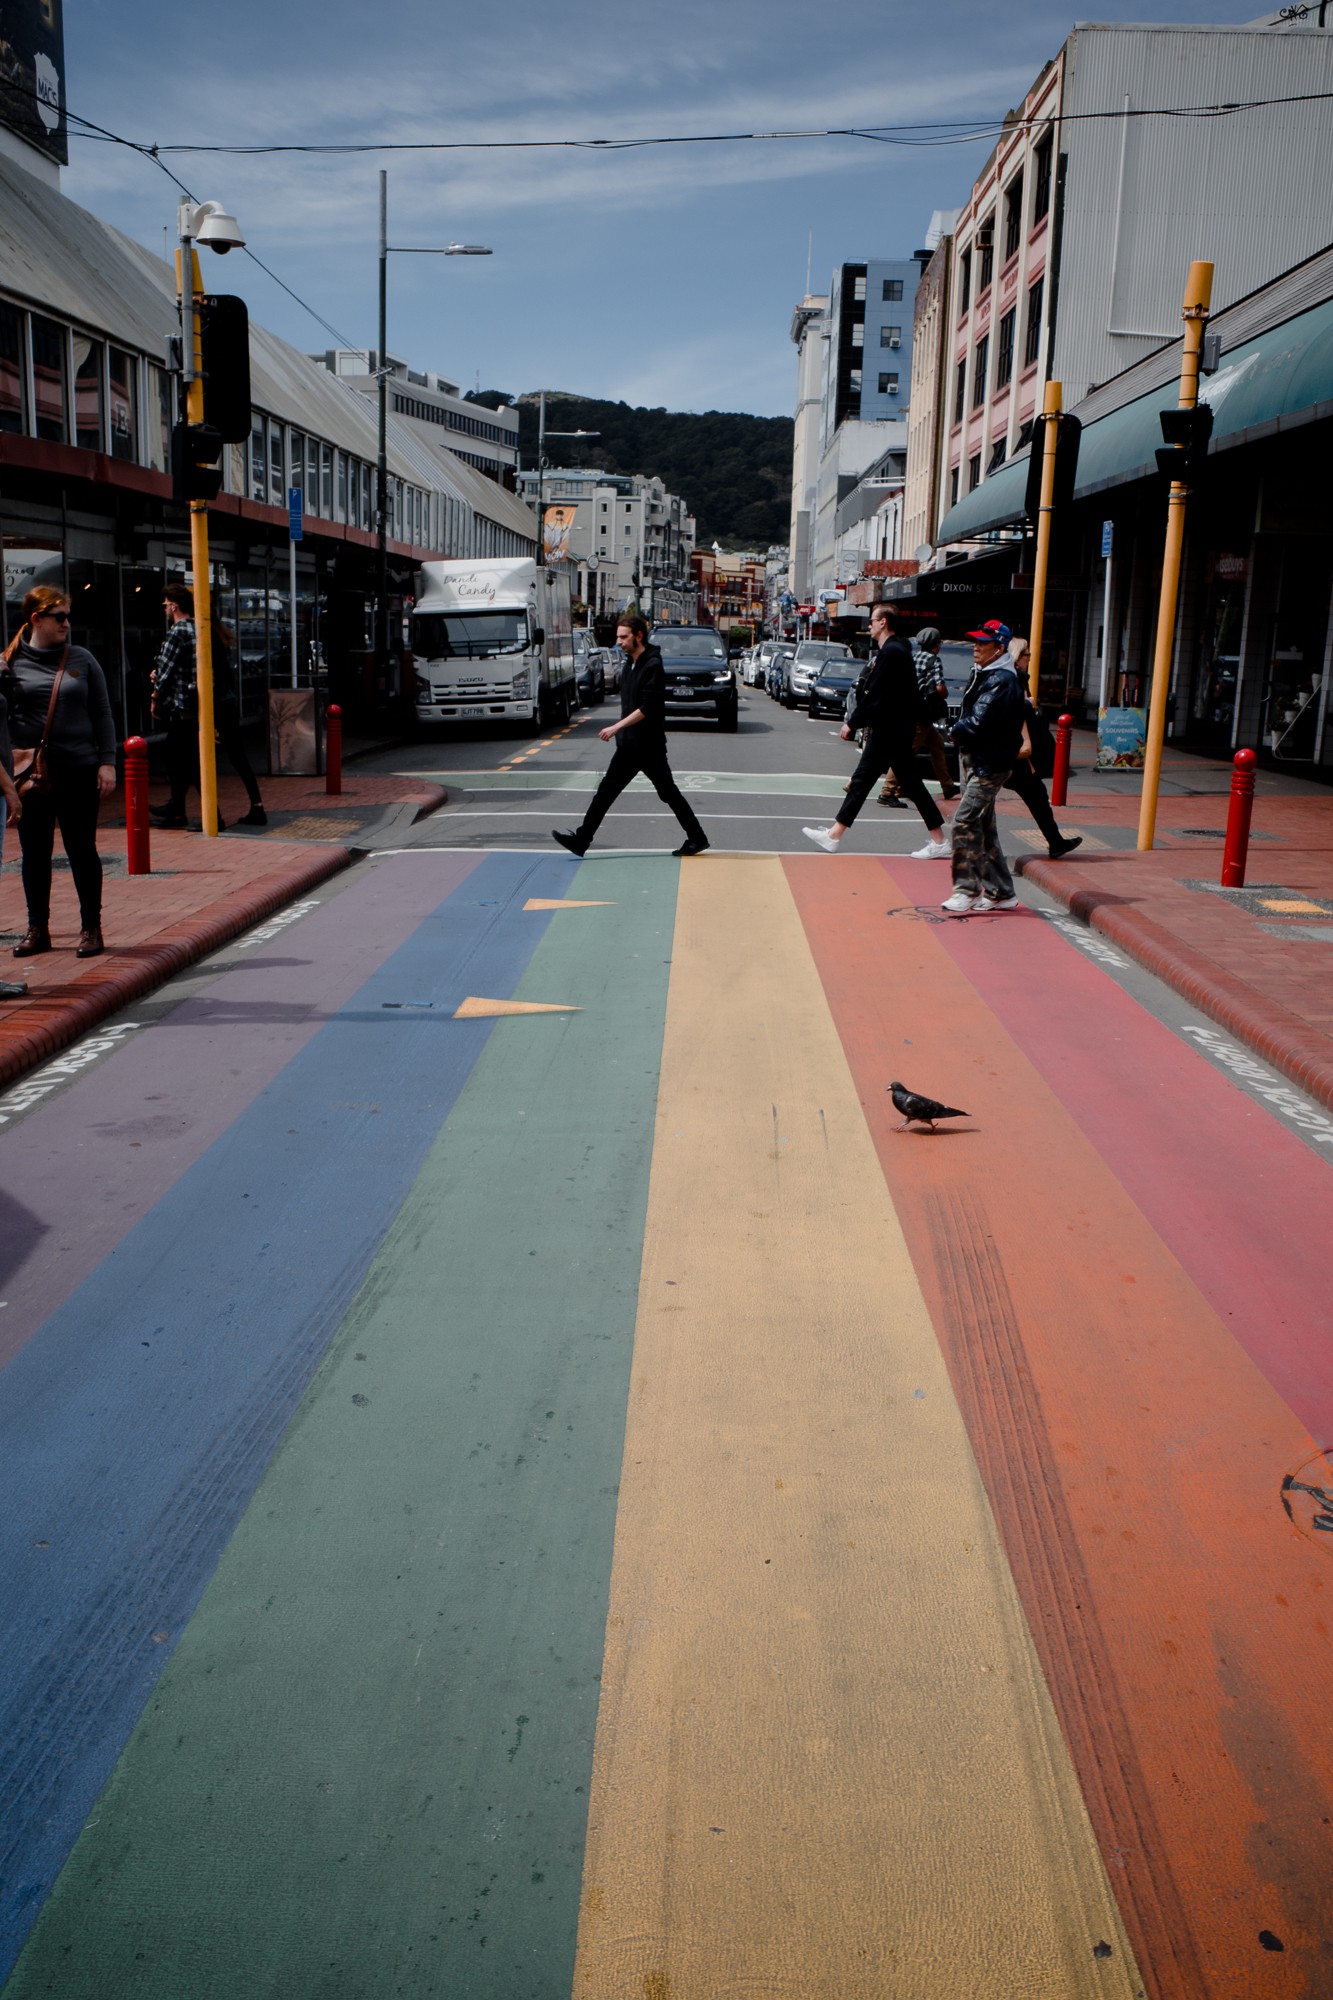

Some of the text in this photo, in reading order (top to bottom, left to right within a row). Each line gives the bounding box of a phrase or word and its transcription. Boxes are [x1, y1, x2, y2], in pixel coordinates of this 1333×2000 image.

[444, 574, 479, 585] Dandi
[942, 583, 973, 593] DIXON
[458, 583, 496, 600] Candy
[33, 1034, 126, 1079] LOOK
[1192, 1035, 1278, 1083] RIGHT
